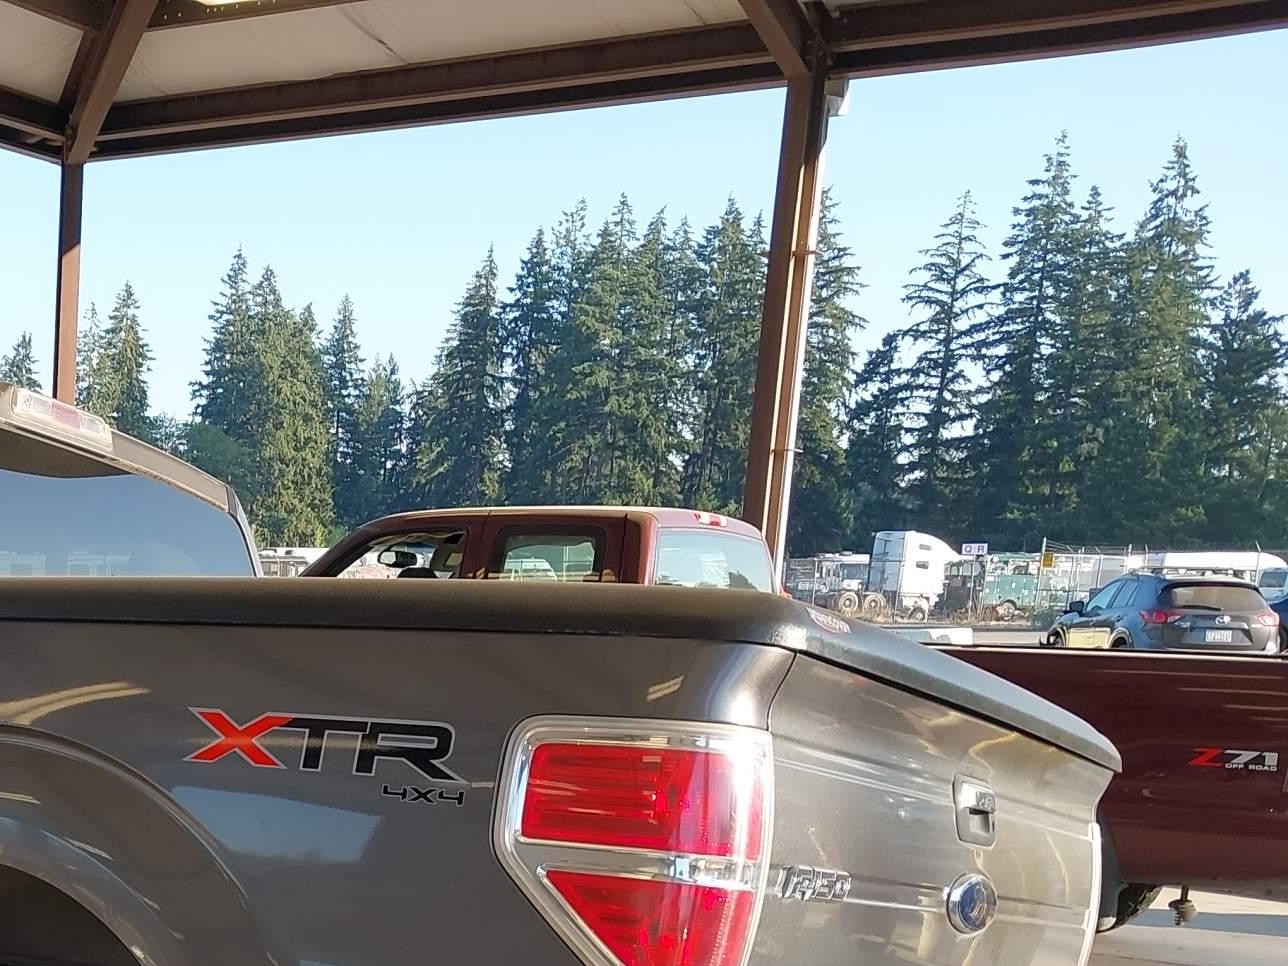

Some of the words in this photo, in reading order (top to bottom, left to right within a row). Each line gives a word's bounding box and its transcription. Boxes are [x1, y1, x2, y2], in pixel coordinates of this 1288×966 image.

[182, 706, 469, 784] XTR
[1188, 746, 1279, 768] Z71
[1224, 763, 1245, 771] OFF
[1248, 764, 1278, 772] ROAD
